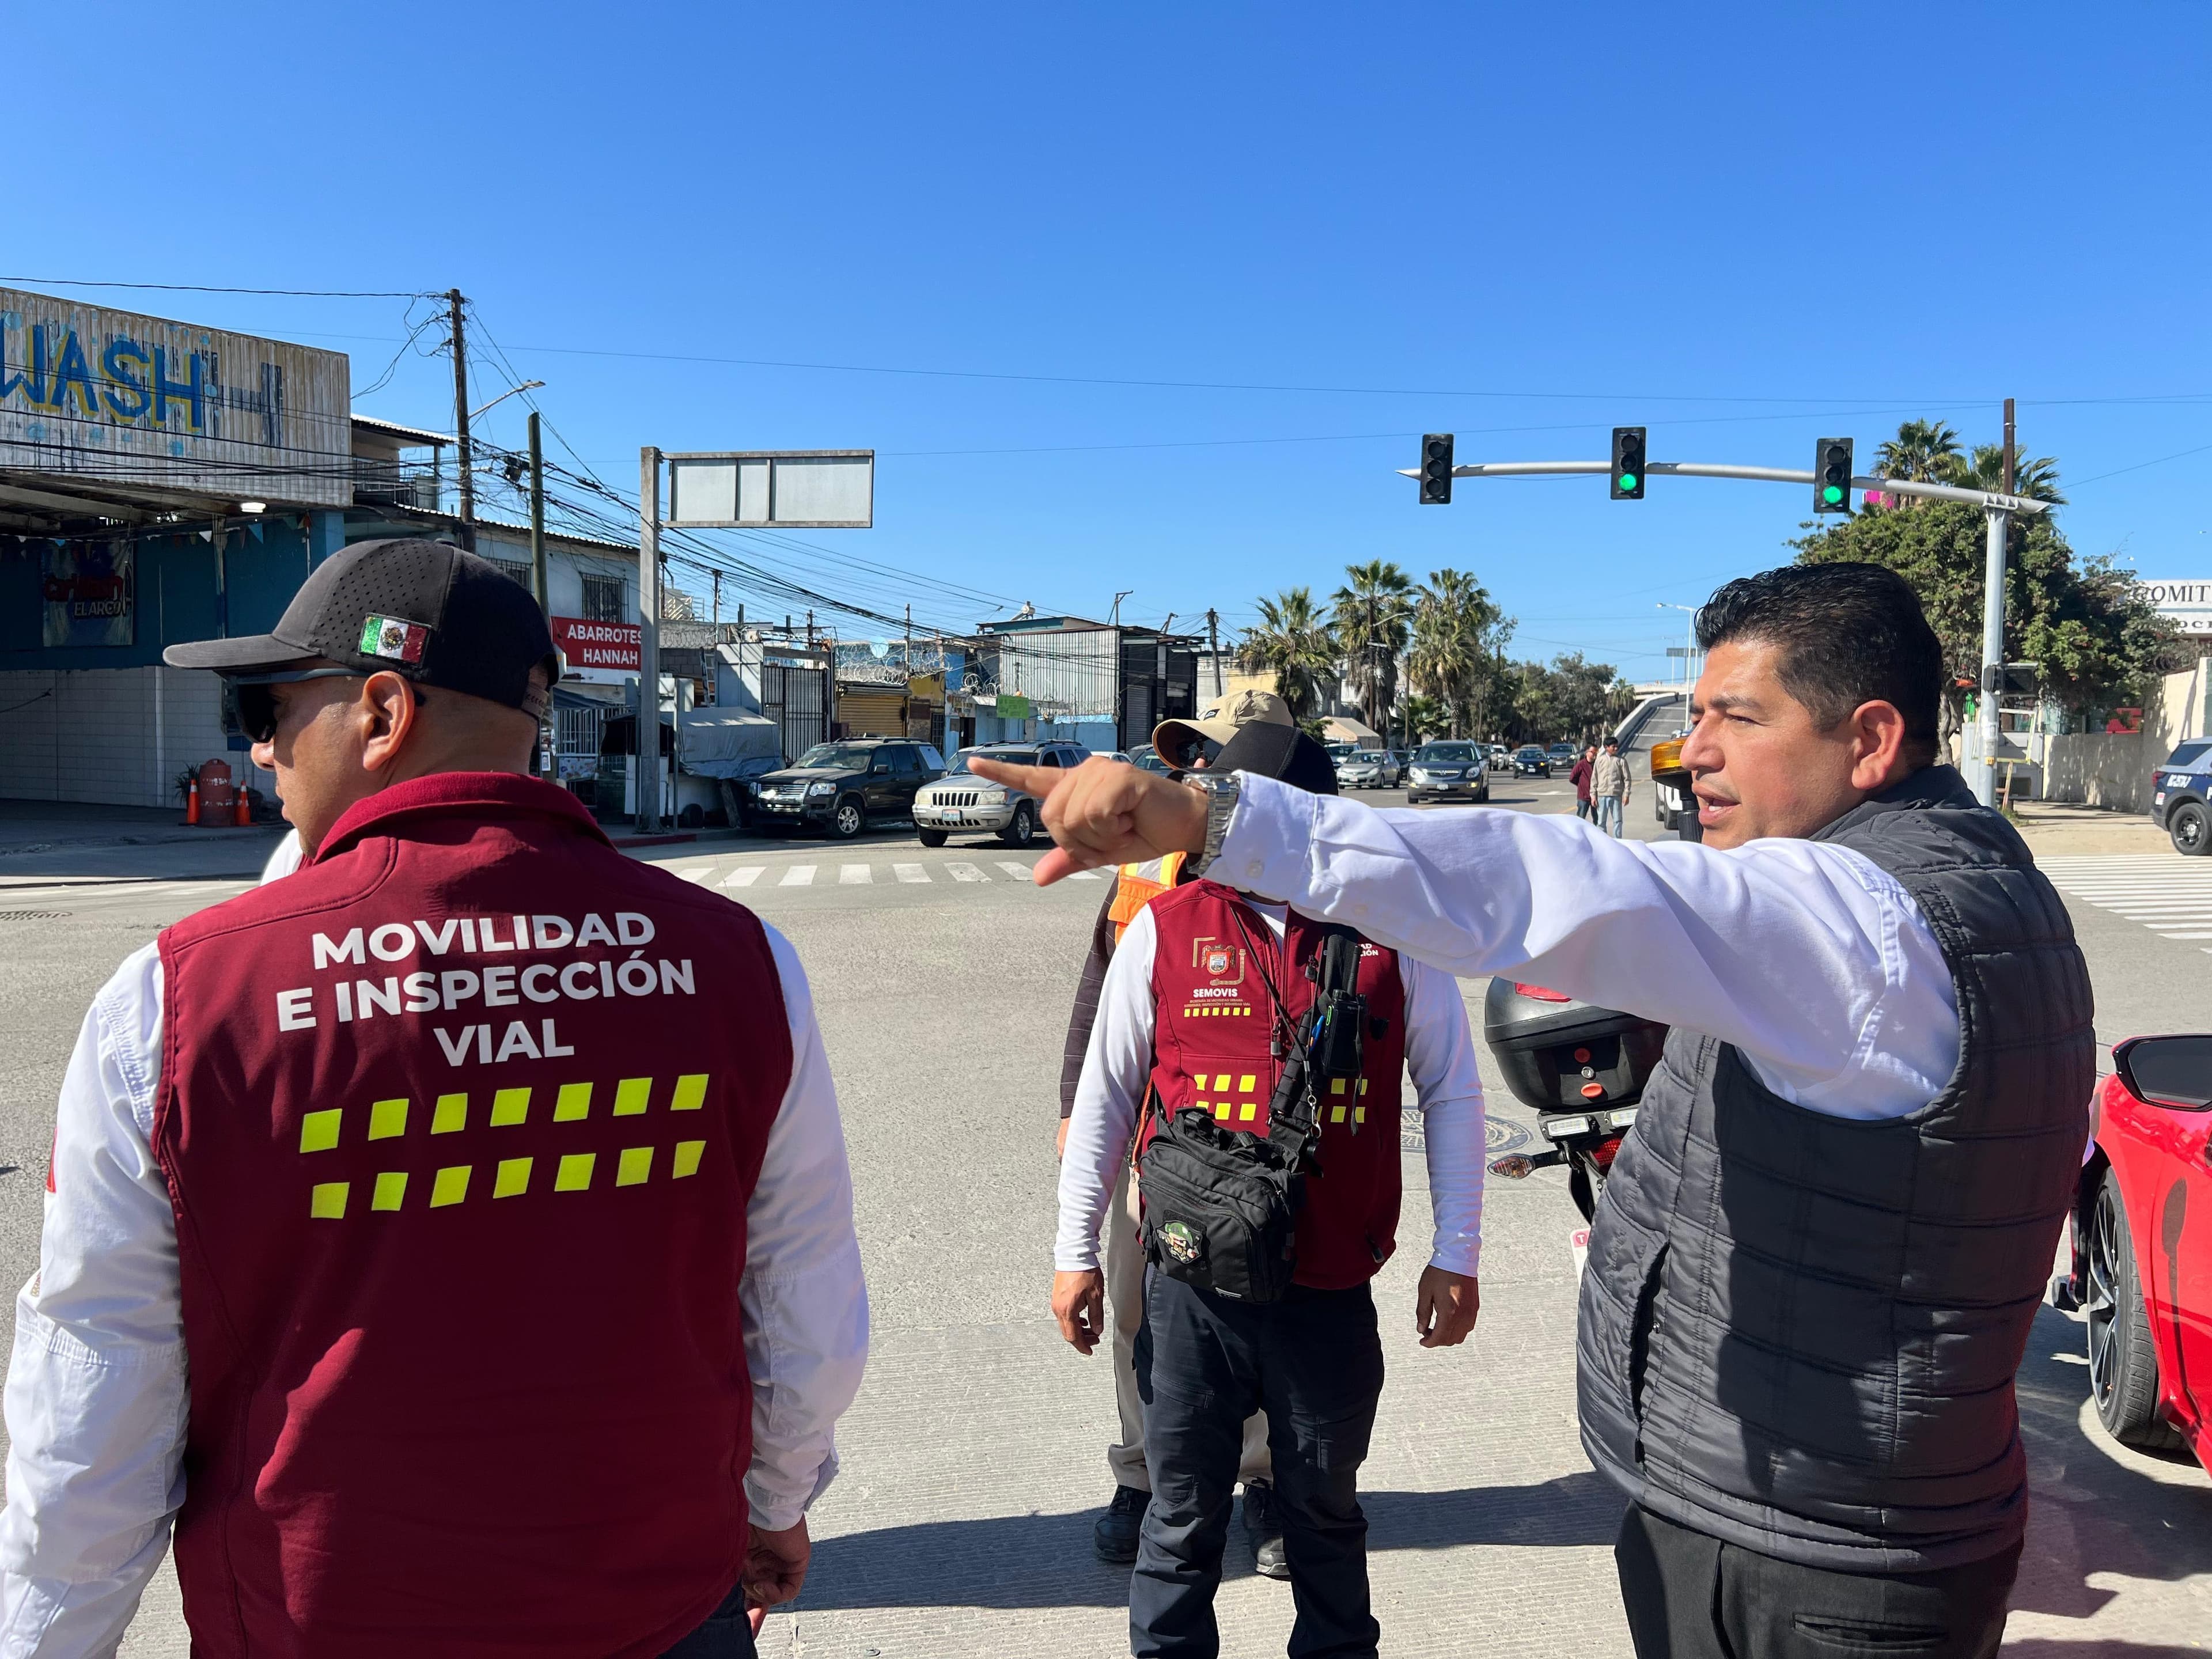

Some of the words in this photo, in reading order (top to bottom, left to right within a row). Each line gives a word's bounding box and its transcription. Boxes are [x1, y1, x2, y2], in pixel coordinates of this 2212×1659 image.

[0, 317, 203, 432] WASH
[74, 601, 88, 616] EL
[584, 648, 638, 665] HANNAH
[312, 912, 656, 970] MOVILIDAD
[276, 987, 317, 1032] E
[335, 950, 696, 1022] INSPECCIÓN
[1193, 988, 1238, 998] SEMOVIS
[433, 1018, 574, 1067] VIAL
